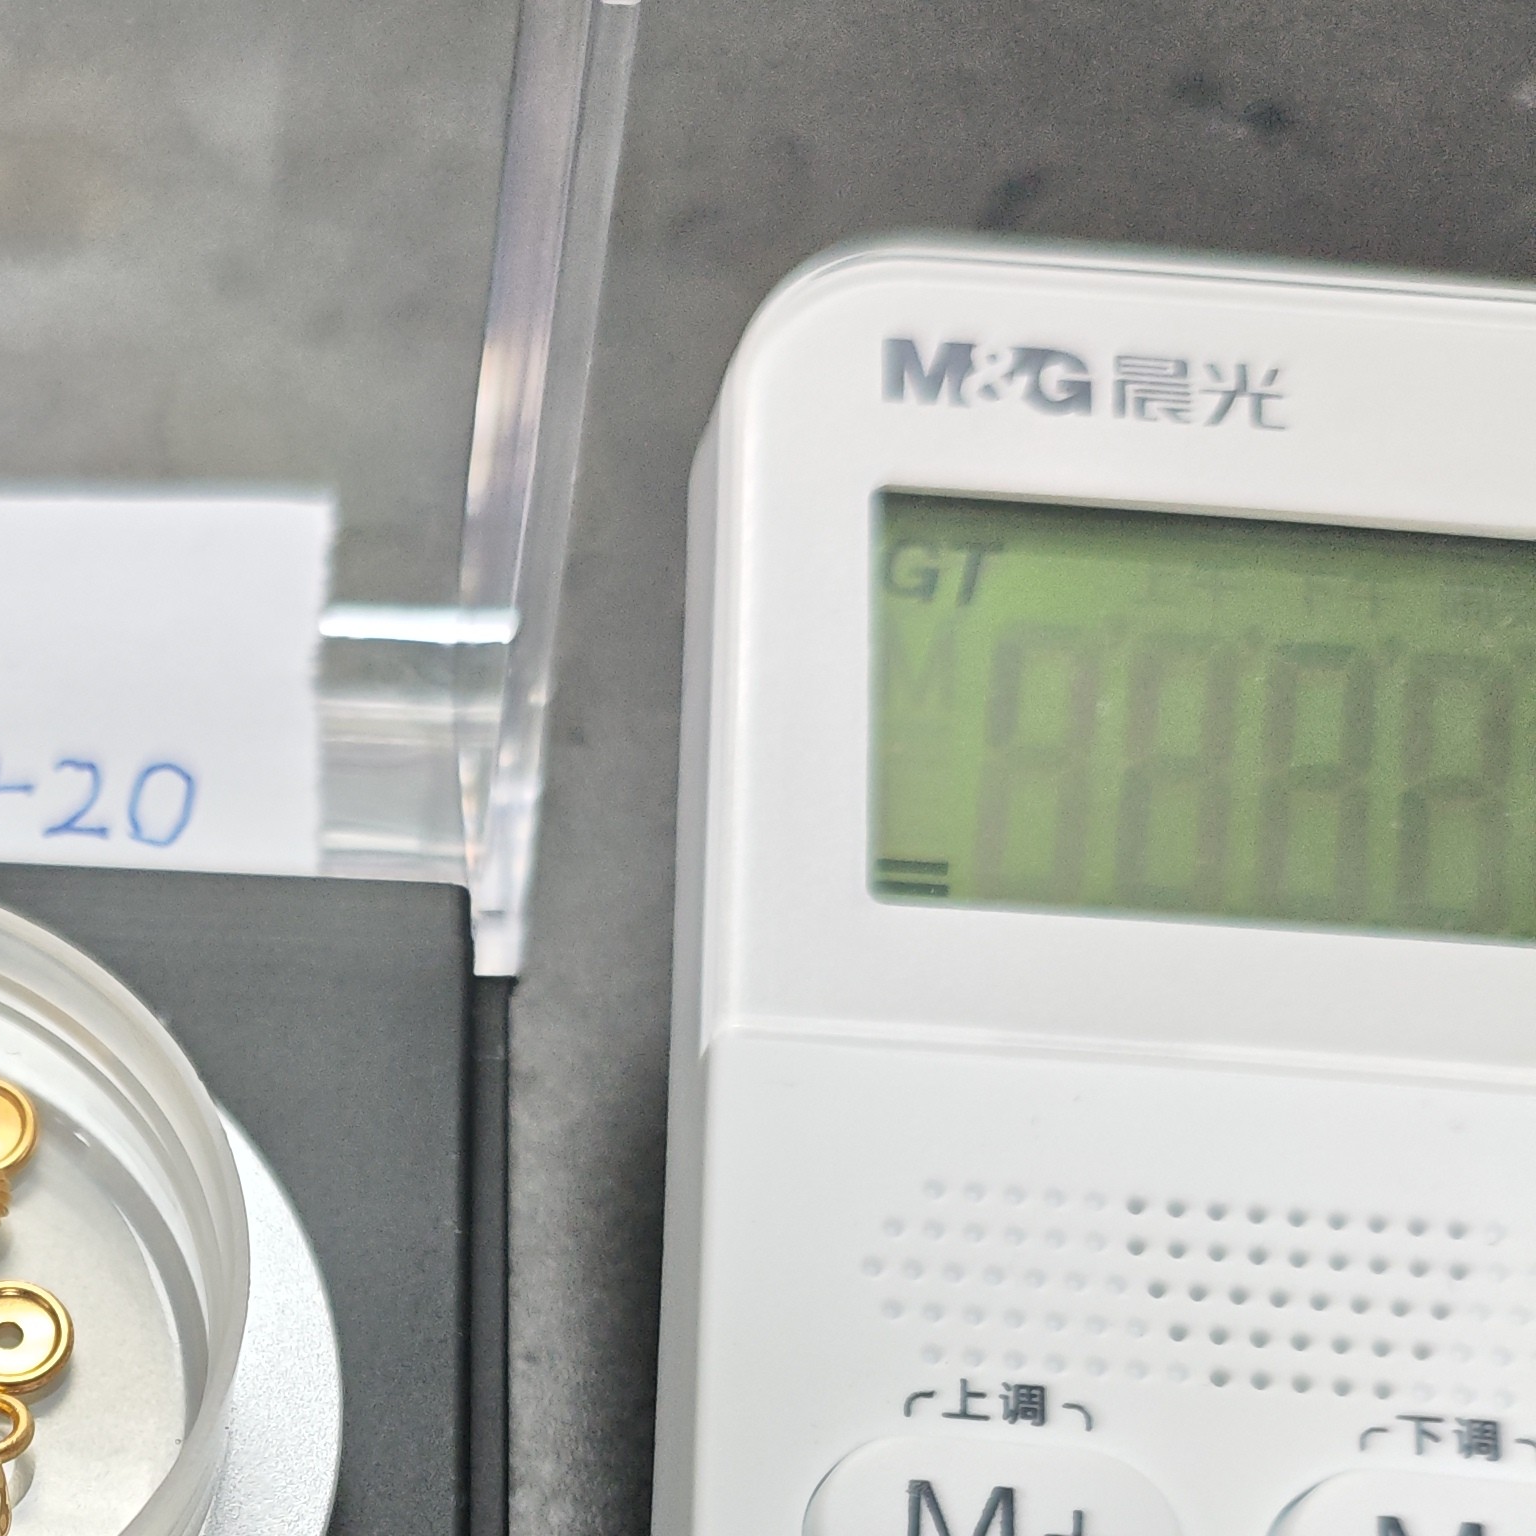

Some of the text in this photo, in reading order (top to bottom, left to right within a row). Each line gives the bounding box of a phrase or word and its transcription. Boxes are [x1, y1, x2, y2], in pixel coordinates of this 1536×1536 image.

[880, 337, 1291, 431] M&G 晨光
[883, 539, 1004, 607] GT
[941, 1378, 1046, 1427] 上调
[1394, 1414, 1501, 1462] 下调
